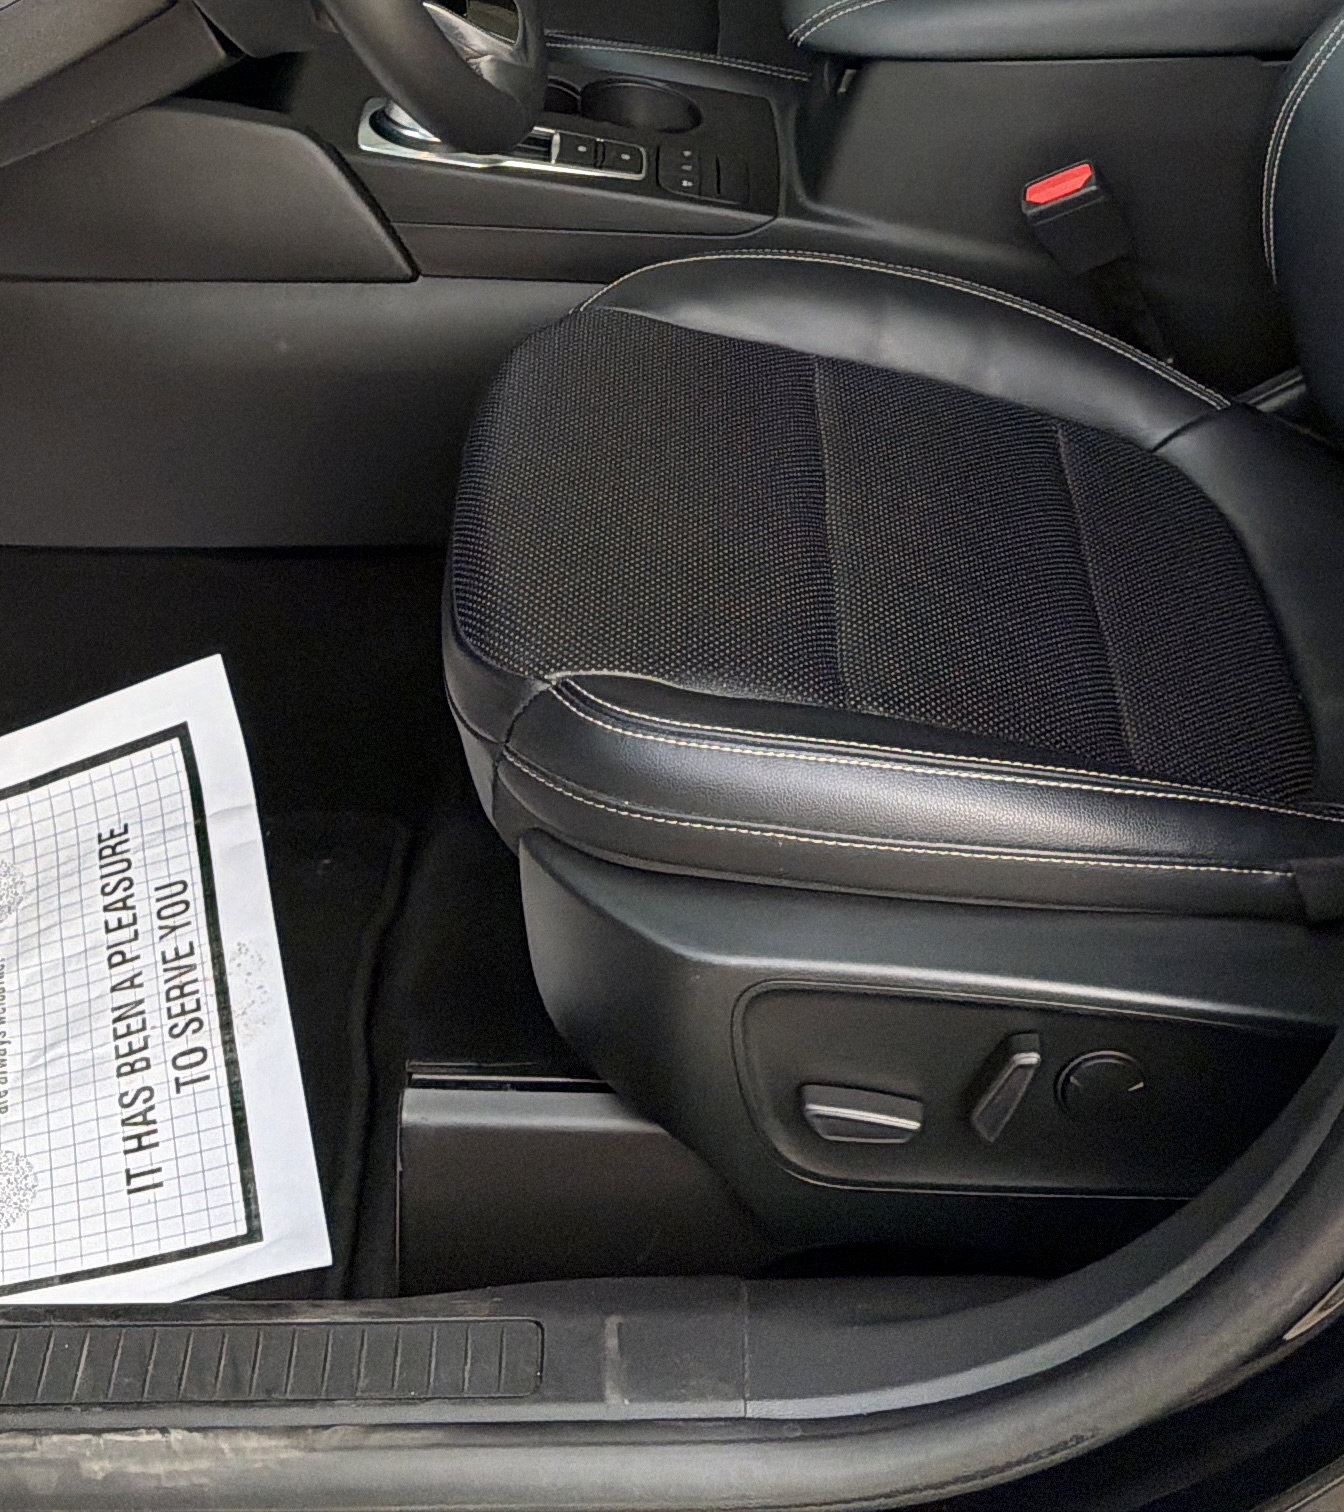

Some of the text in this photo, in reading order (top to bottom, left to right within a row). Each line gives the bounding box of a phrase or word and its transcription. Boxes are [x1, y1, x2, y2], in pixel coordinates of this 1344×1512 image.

[98, 822, 164, 1195] IT HAS BEEN A PLEASURE
[154, 878, 211, 1094] TO SERVE YOU
